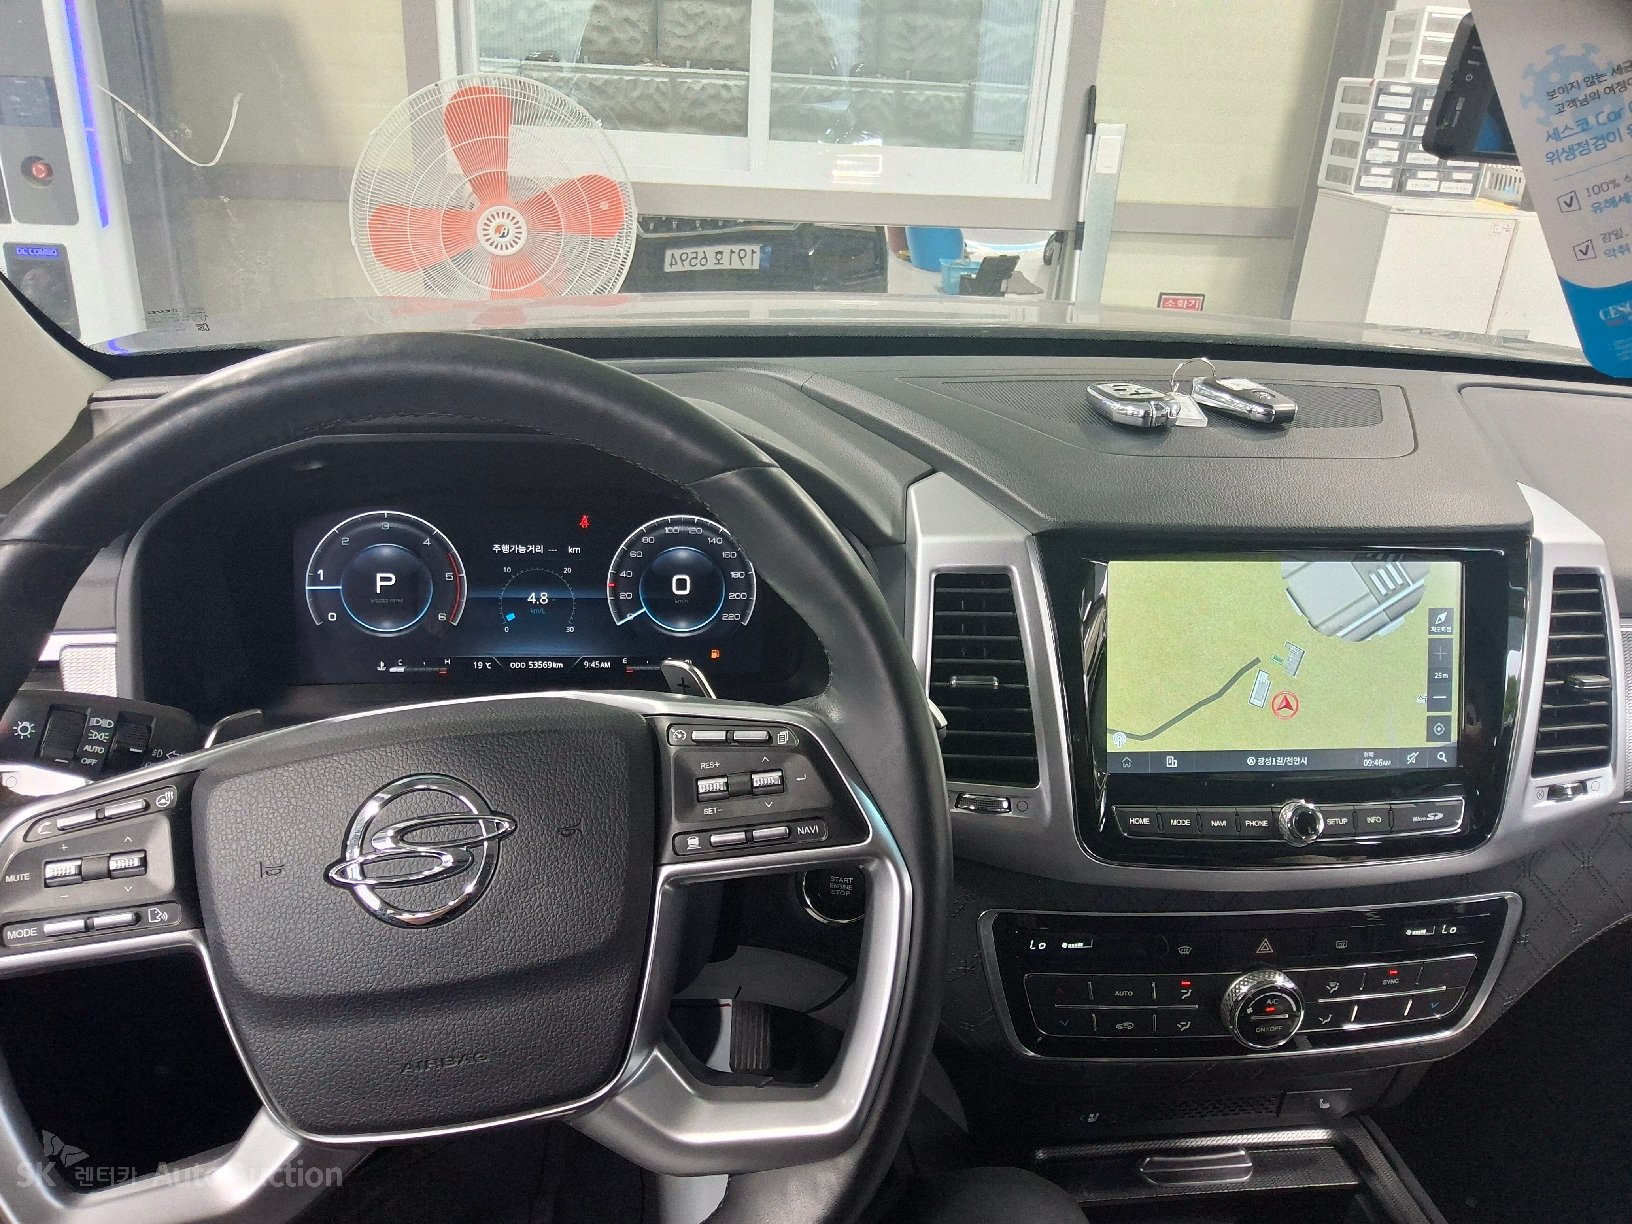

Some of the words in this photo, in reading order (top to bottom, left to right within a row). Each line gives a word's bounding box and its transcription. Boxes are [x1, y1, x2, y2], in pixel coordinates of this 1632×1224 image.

[1546, 79, 1581, 101] 보이지
[1583, 72, 1607, 88] 않는
[1554, 89, 1600, 115] 고객님의
[1545, 117, 1592, 142] 세스코
[1595, 107, 1624, 126] Car
[1545, 127, 1623, 165] 위생점검이
[1585, 179, 1621, 197] 100%
[1164, 299, 1199, 309] 소화기
[381, 521, 390, 530] 3
[341, 537, 350, 546] 2
[423, 537, 432, 546] 4
[641, 536, 655, 544] 80
[707, 537, 723, 545] 140
[492, 544, 544, 554] 주행가능거리
[568, 546, 581, 554] km
[317, 569, 324, 581] 1
[445, 572, 454, 581] 5
[619, 570, 633, 578] 40
[376, 573, 396, 594] P
[671, 574, 691, 595] 0
[527, 592, 549, 605] 4.8
[328, 612, 337, 621] 0
[438, 613, 447, 621] 6
[722, 613, 741, 621] 220
[473, 661, 483, 669] 19
[83, 744, 105, 754] AUTO
[81, 758, 98, 766] OFF
[700, 761, 720, 770] RES+
[1129, 817, 1150, 825] HOME
[1326, 817, 1348, 825] SETUP
[1366, 815, 1382, 823] INFO
[797, 825, 819, 835] NAVI
[5, 872, 30, 883] MUTE
[830, 875, 853, 884] START
[7, 927, 37, 939] MODE
[1382, 977, 1400, 985] SYNC
